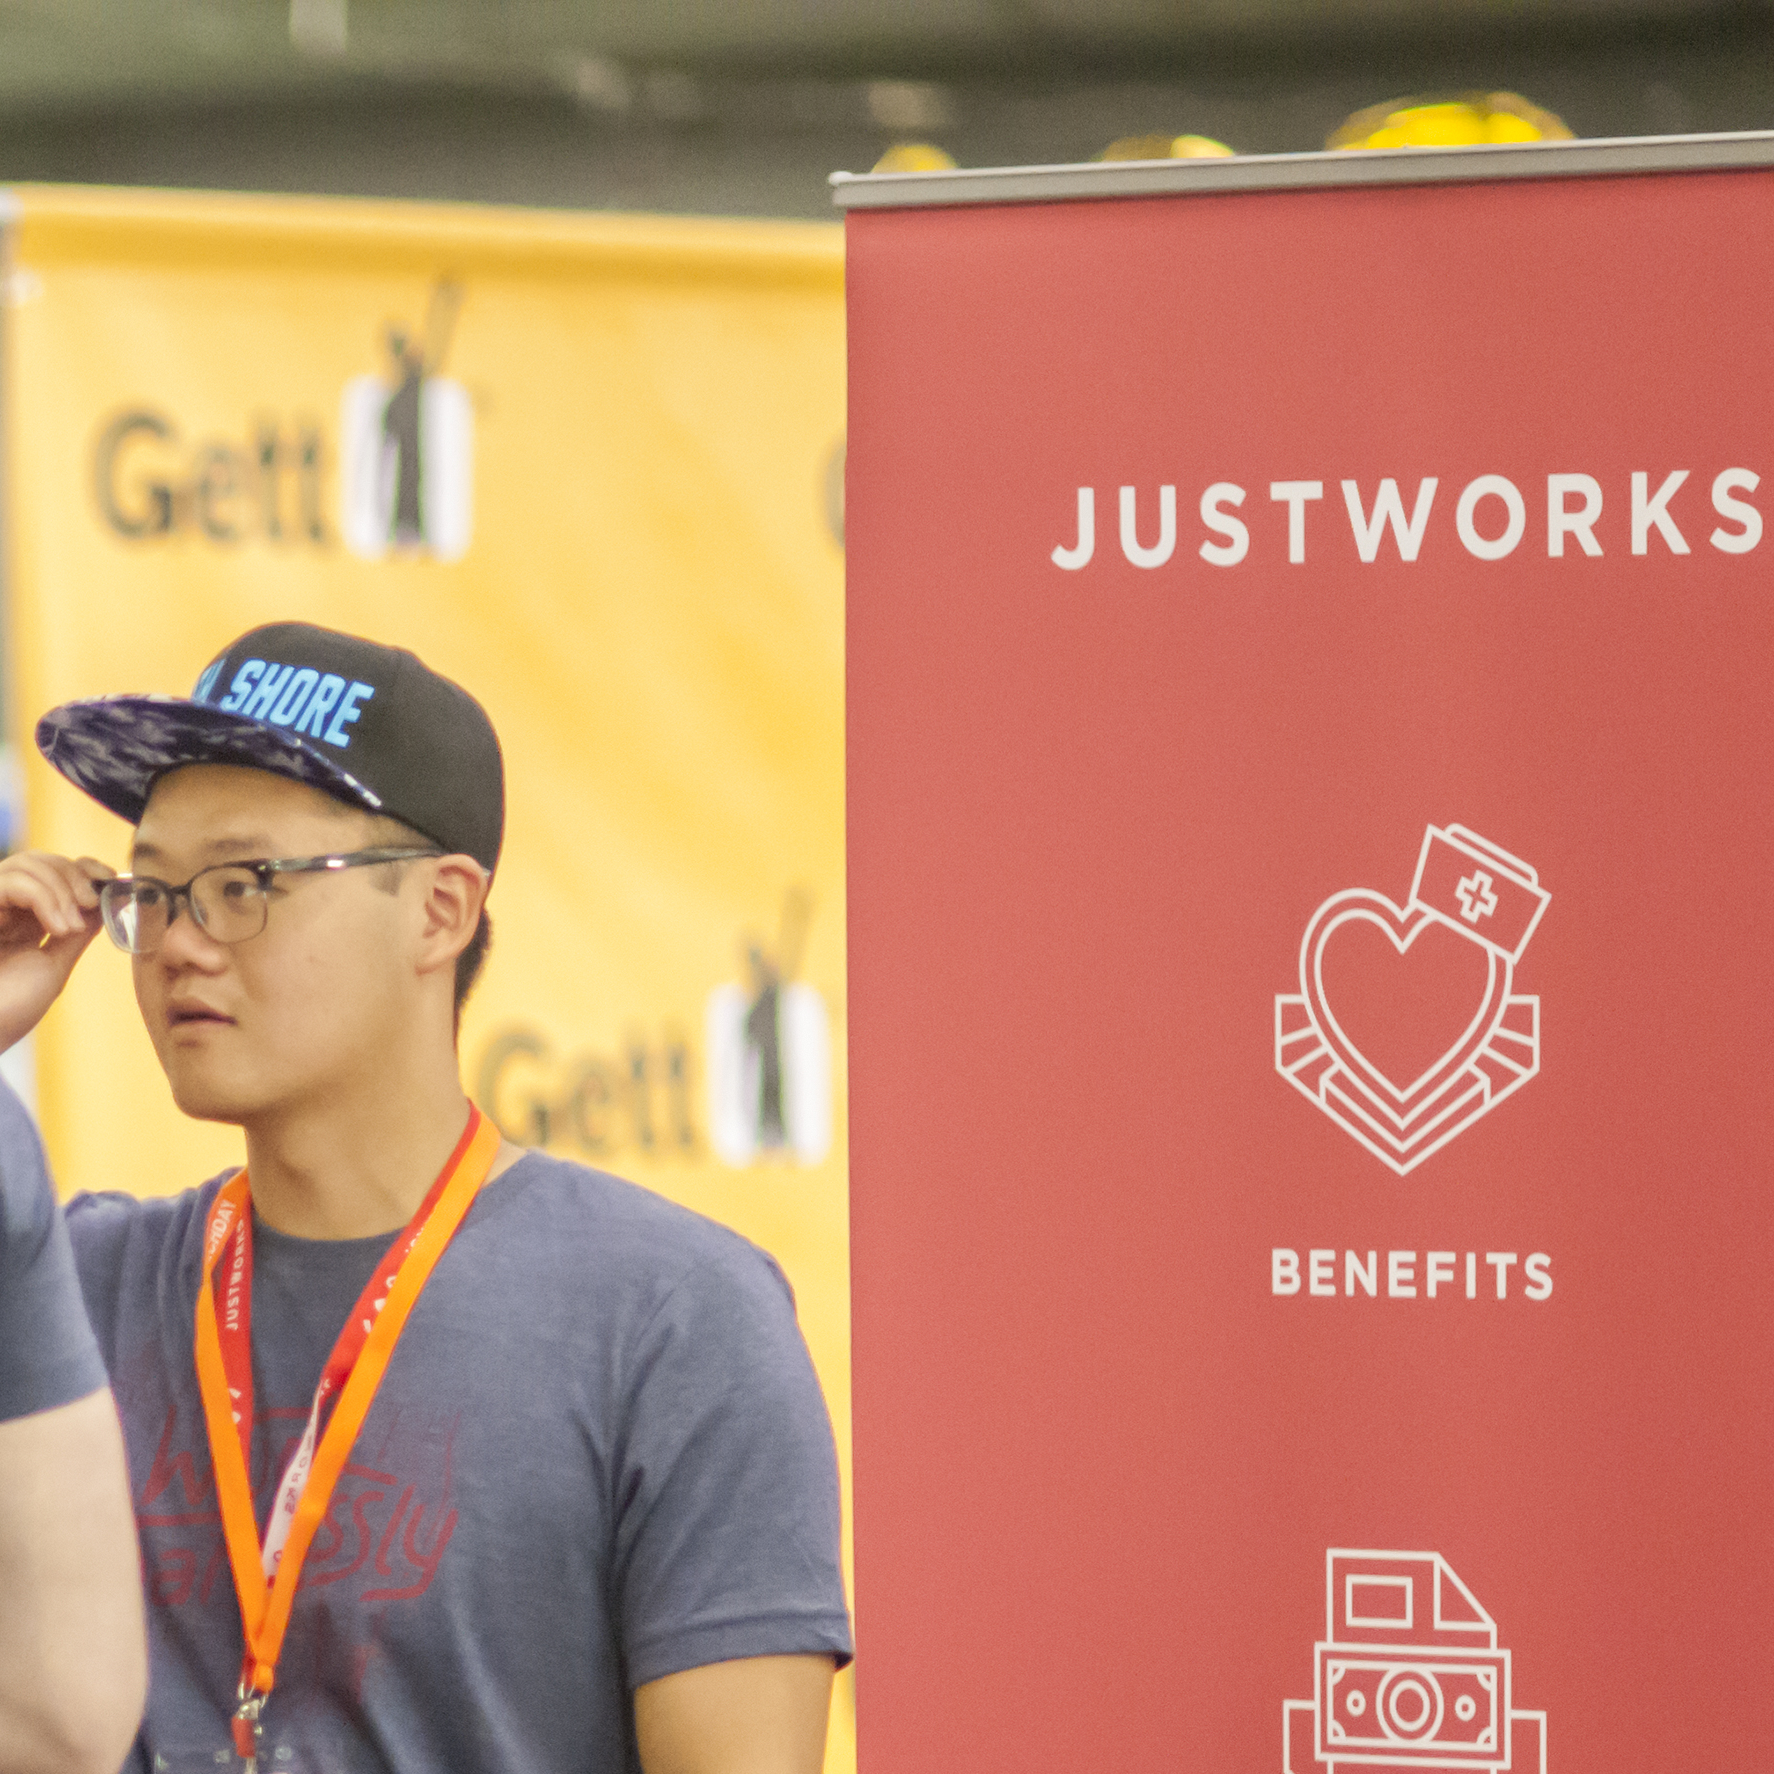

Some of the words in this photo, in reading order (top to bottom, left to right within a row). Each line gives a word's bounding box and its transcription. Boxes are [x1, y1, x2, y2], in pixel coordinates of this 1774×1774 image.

[1050, 467, 1763, 571] JUSTWORKS
[220, 657, 376, 749] SHORE
[1271, 1248, 1554, 1301] BENEFITS
